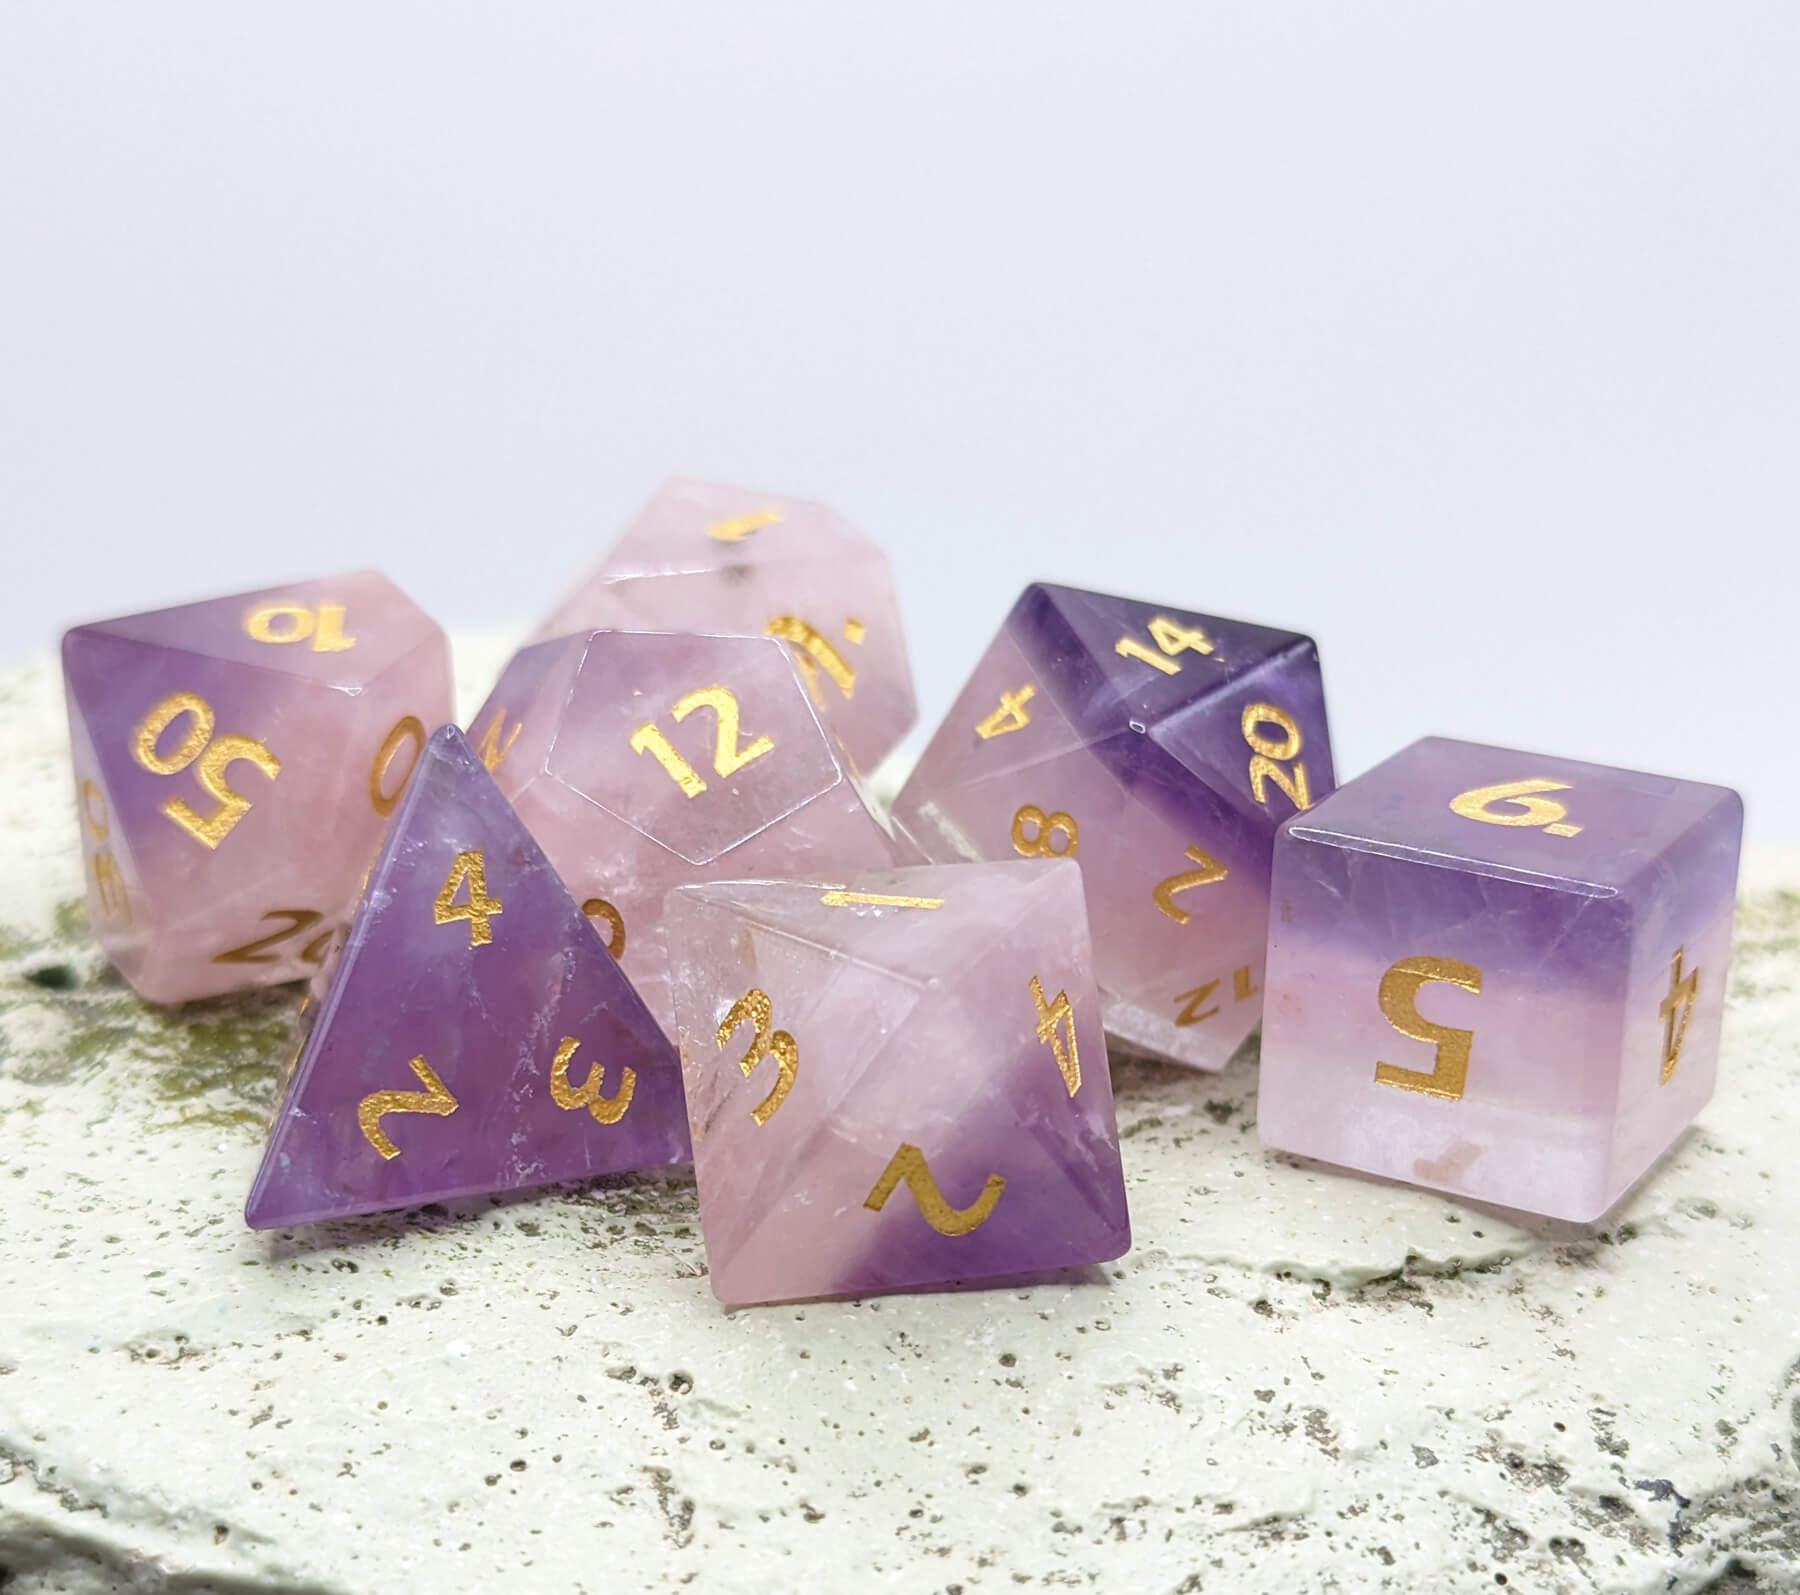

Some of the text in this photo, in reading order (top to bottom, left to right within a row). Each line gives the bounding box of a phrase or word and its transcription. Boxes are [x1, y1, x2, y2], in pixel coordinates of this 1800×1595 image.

[244, 601, 357, 653] 10
[1116, 617, 1215, 675] 14
[629, 685, 774, 799] 12
[975, 684, 1037, 740] 4
[1241, 703, 1312, 811] 20
[434, 850, 503, 946] 4
[1153, 844, 1229, 925] 2
[1028, 975, 1082, 1098] 4
[1173, 965, 1260, 1028] 12
[1374, 955, 1483, 1101] 5
[1659, 945, 1700, 1086] 4
[550, 1036, 637, 1126] 3
[715, 988, 799, 1127] 3
[357, 1054, 460, 1161] 2
[862, 1142, 1007, 1237] 2
